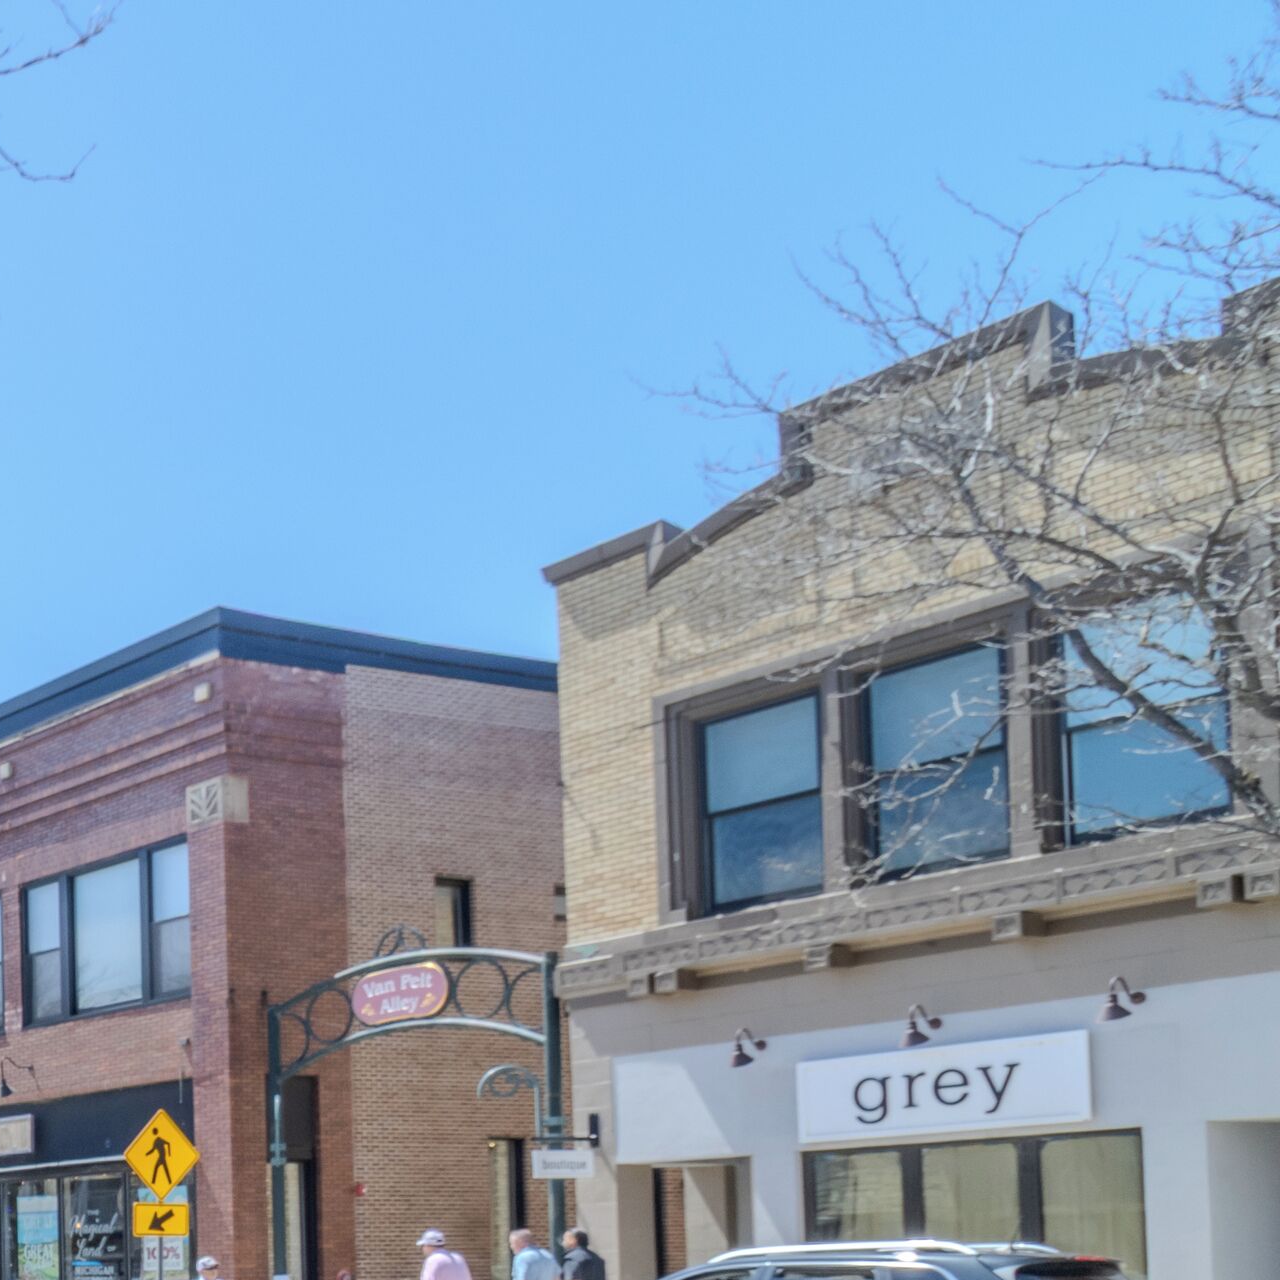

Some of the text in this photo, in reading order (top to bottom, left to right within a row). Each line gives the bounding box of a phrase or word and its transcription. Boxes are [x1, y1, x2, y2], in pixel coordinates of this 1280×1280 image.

[362, 972, 433, 998] Van Pelt
[380, 995, 419, 1015] Alley
[853, 1061, 1020, 1125] grey
[70, 1211, 119, 1241] Magical
[23, 1244, 54, 1259] GREAT
[76, 1236, 107, 1261] Land
